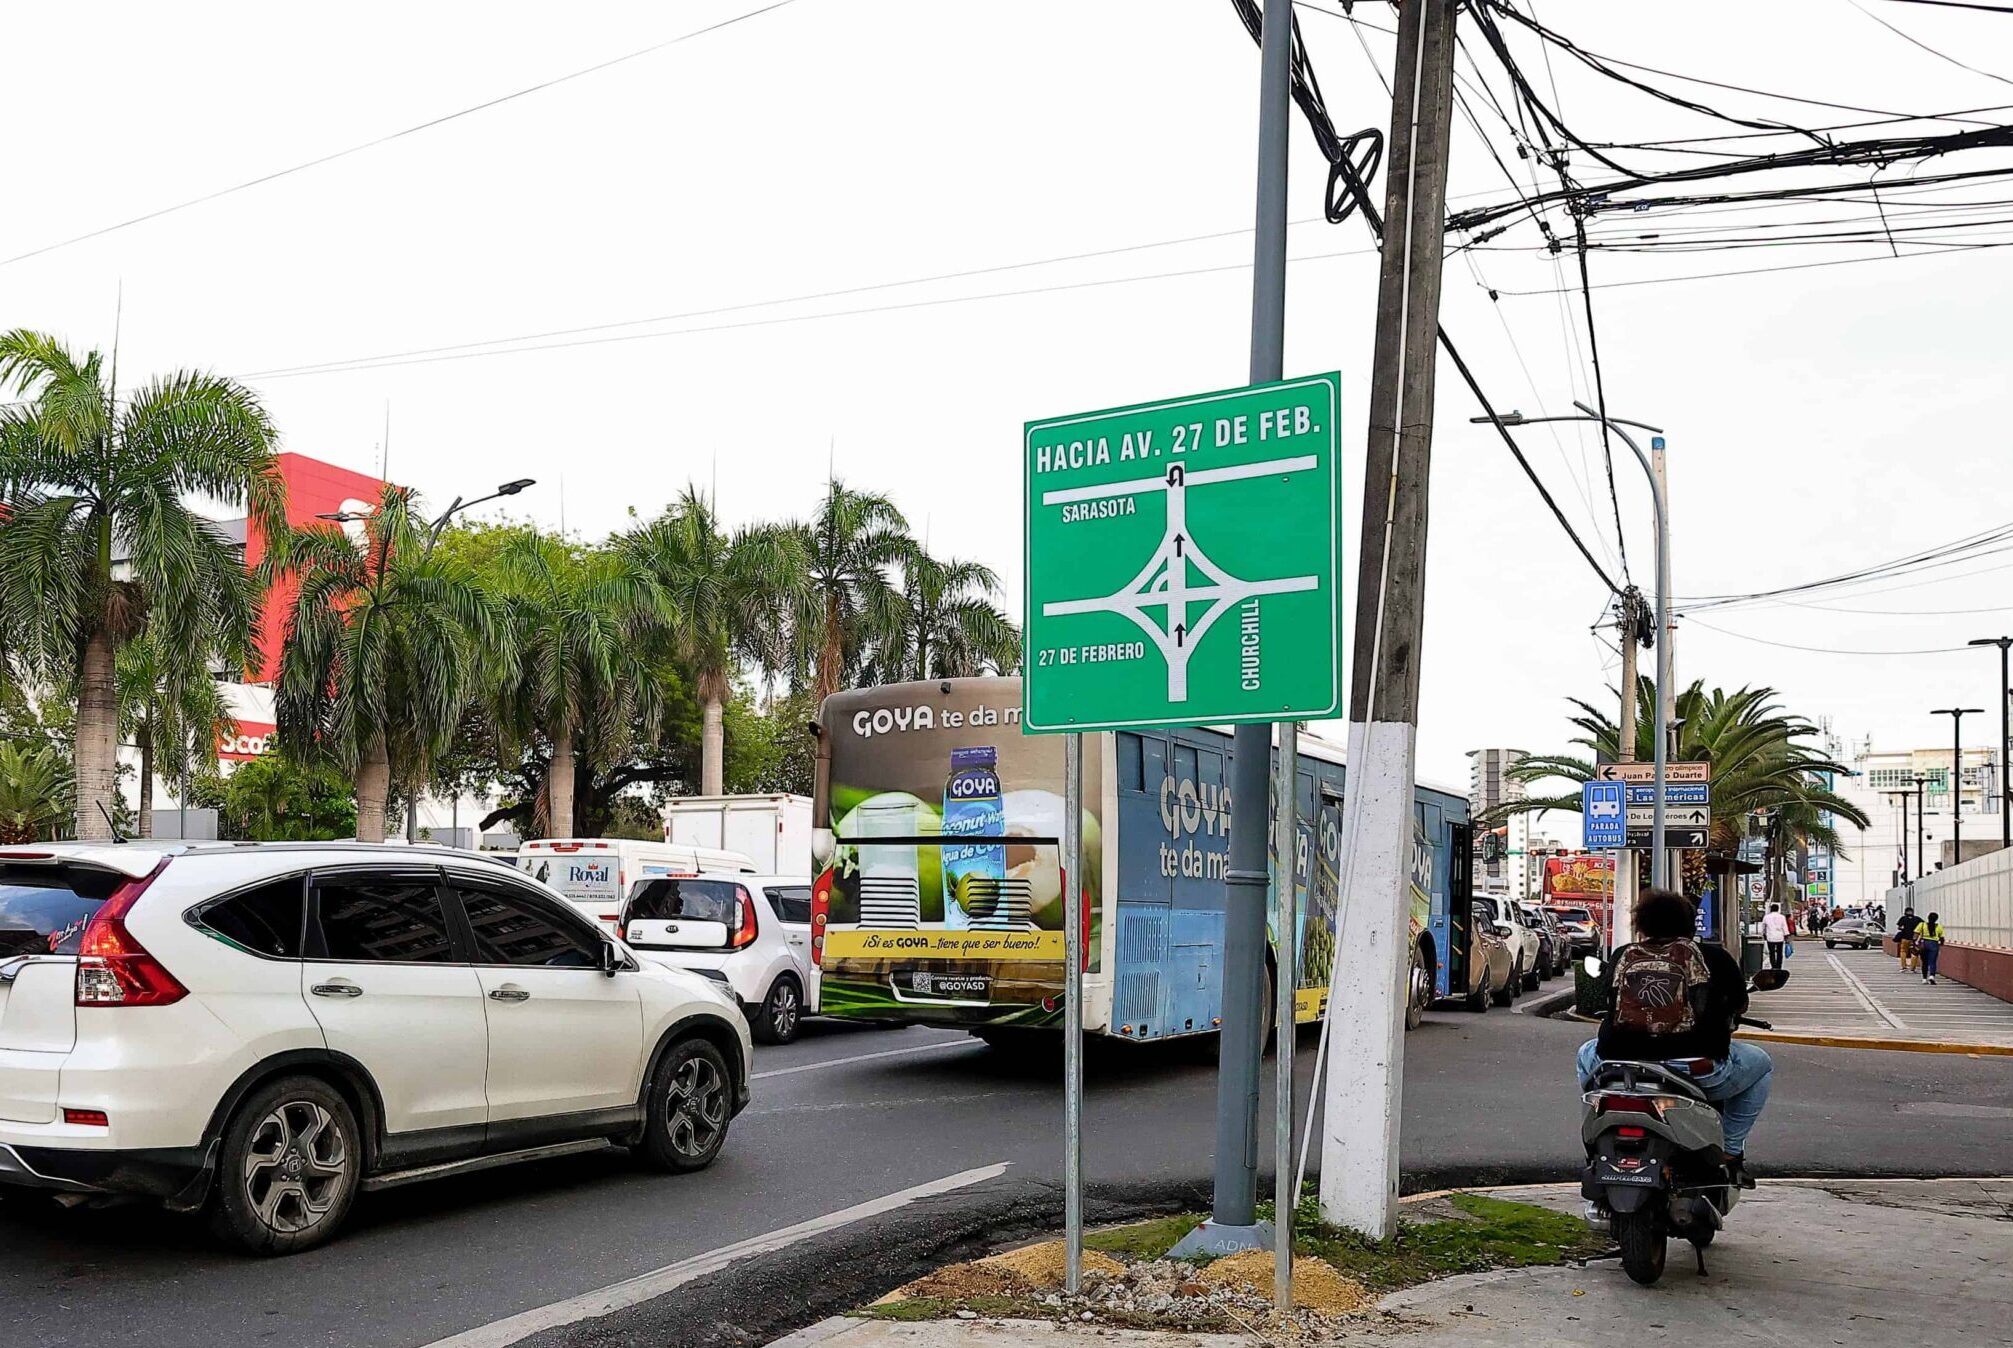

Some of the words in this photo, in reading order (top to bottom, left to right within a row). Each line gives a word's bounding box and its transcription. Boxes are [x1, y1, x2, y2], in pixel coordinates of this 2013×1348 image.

[1037, 437, 1110, 473] HACIA
[1120, 430, 1161, 461] AV.
[1172, 422, 1203, 454] 27
[1215, 415, 1248, 447] DE
[1260, 405, 1321, 441] FEB.
[1062, 497, 1135, 523] SARASOTA
[1039, 649, 1056, 666] 27
[1060, 647, 1077, 665] DE
[1081, 641, 1145, 663] FEBRERO
[1241, 599, 1261, 691] CHURCHILL
[852, 705, 935, 738] GOYA
[941, 708, 965, 728] te
[968, 704, 998, 726] da
[1621, 772, 1643, 780] Juan
[1673, 771, 1703, 779] Duarte
[952, 778, 996, 797] GOYA
[1664, 793, 1705, 801] méricas
[1160, 775, 1232, 840] GOYA
[1665, 812, 1688, 820] éroes
[1590, 822, 1619, 831] PARADA
[1588, 834, 1622, 843] AUTOBUS
[1160, 841, 1179, 878] te
[1182, 839, 1203, 878] da
[569, 866, 609, 888] Royal
[882, 939, 894, 948] es
[896, 938, 929, 949] GOYA
[962, 940, 980, 957] que
[982, 940, 1001, 949] ser
[939, 981, 985, 991] @GOYASD
